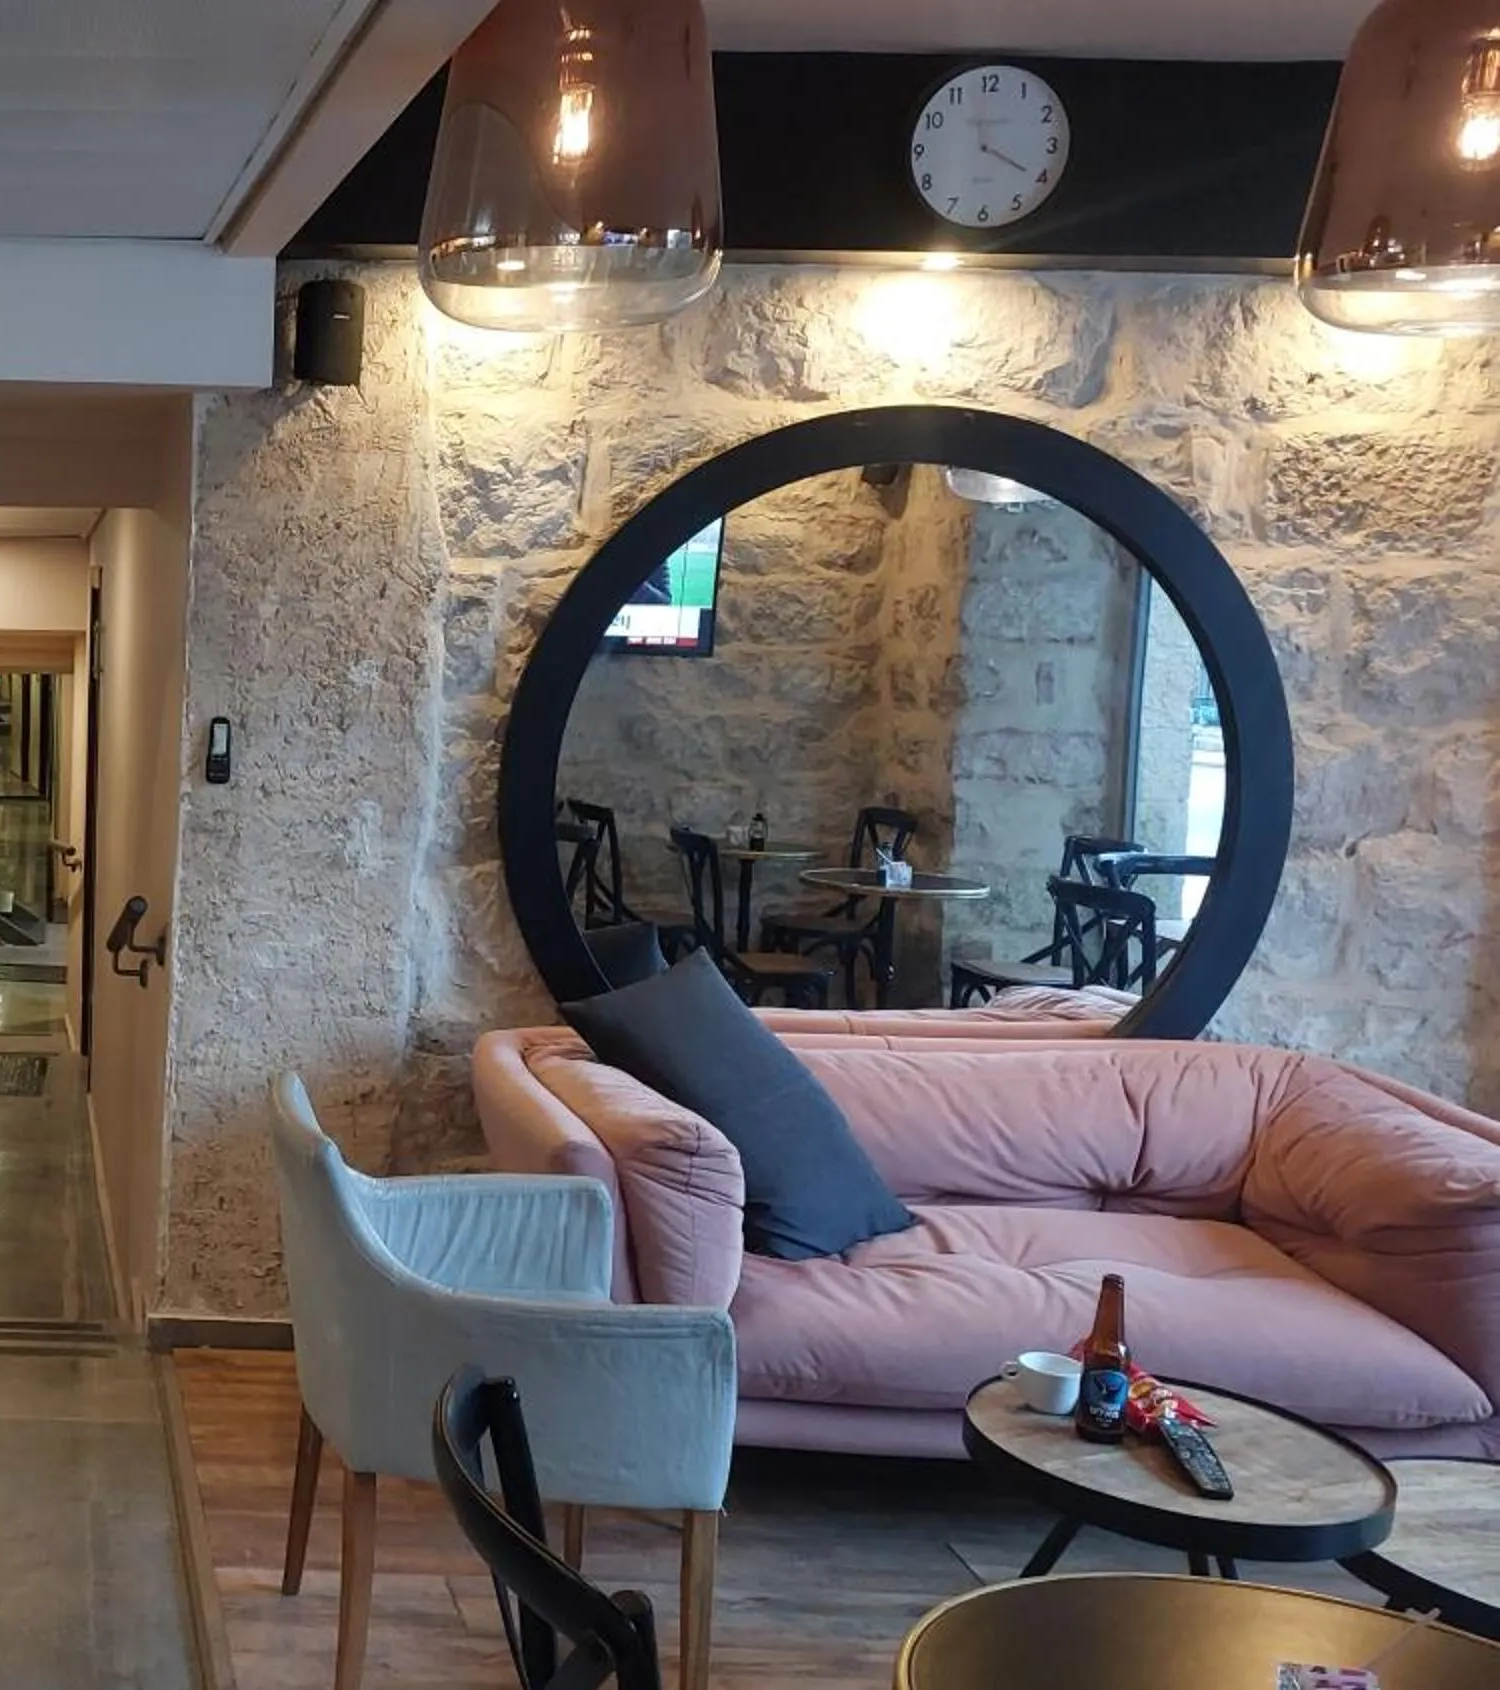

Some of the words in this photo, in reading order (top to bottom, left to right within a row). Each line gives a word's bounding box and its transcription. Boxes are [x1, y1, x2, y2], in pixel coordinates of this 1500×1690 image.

[982, 74, 999, 93] 12
[1021, 82, 1027, 100] 1
[949, 87, 963, 105] 11
[926, 112, 944, 130] 10
[1041, 105, 1053, 124] 2
[914, 144, 925, 161] 9
[1046, 136, 1058, 154] 3
[922, 173, 932, 191] 8
[1035, 167, 1048, 185] 4
[947, 197, 959, 215] 7
[1012, 193, 1022, 211] 5
[978, 204, 989, 222] 6
